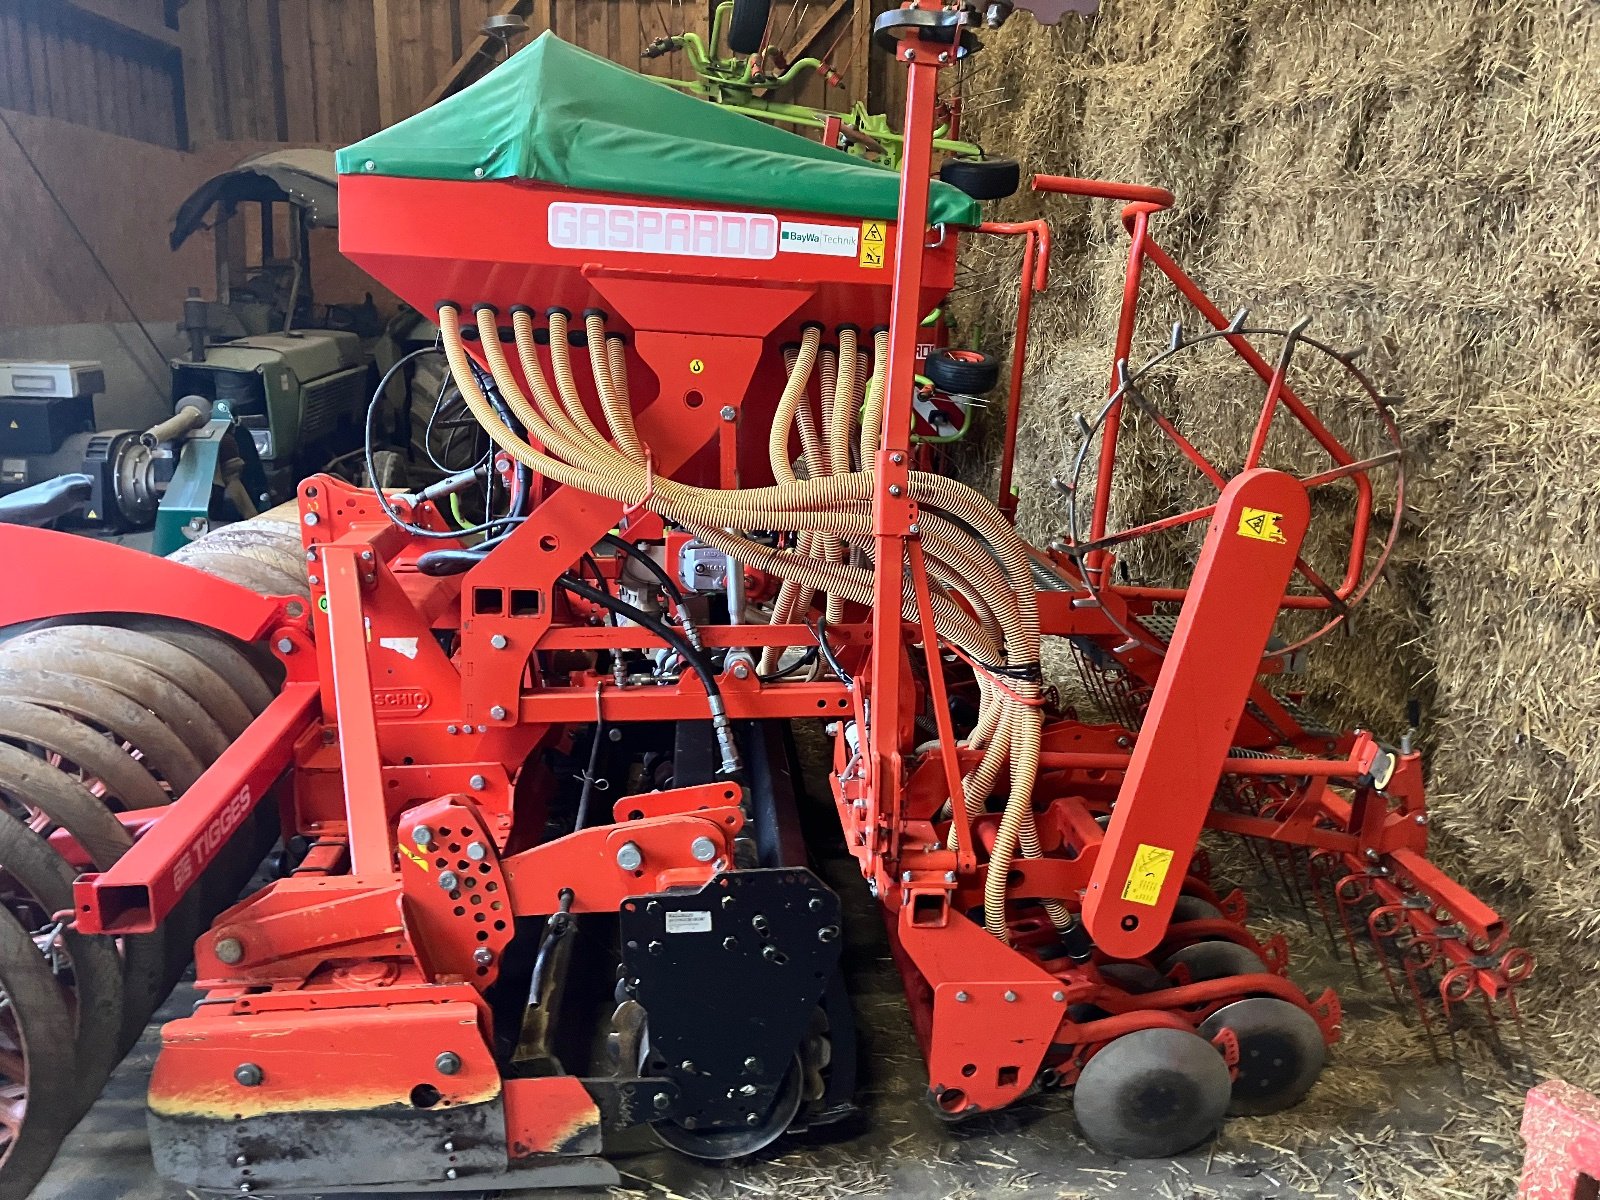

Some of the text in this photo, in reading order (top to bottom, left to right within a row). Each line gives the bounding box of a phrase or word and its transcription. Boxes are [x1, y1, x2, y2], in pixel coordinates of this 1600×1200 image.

[552, 206, 774, 255] GASPARDO
[790, 231, 856, 246] BayWa Technik
[374, 692, 426, 706] SCHIO
[192, 784, 251, 864] TIGGES
